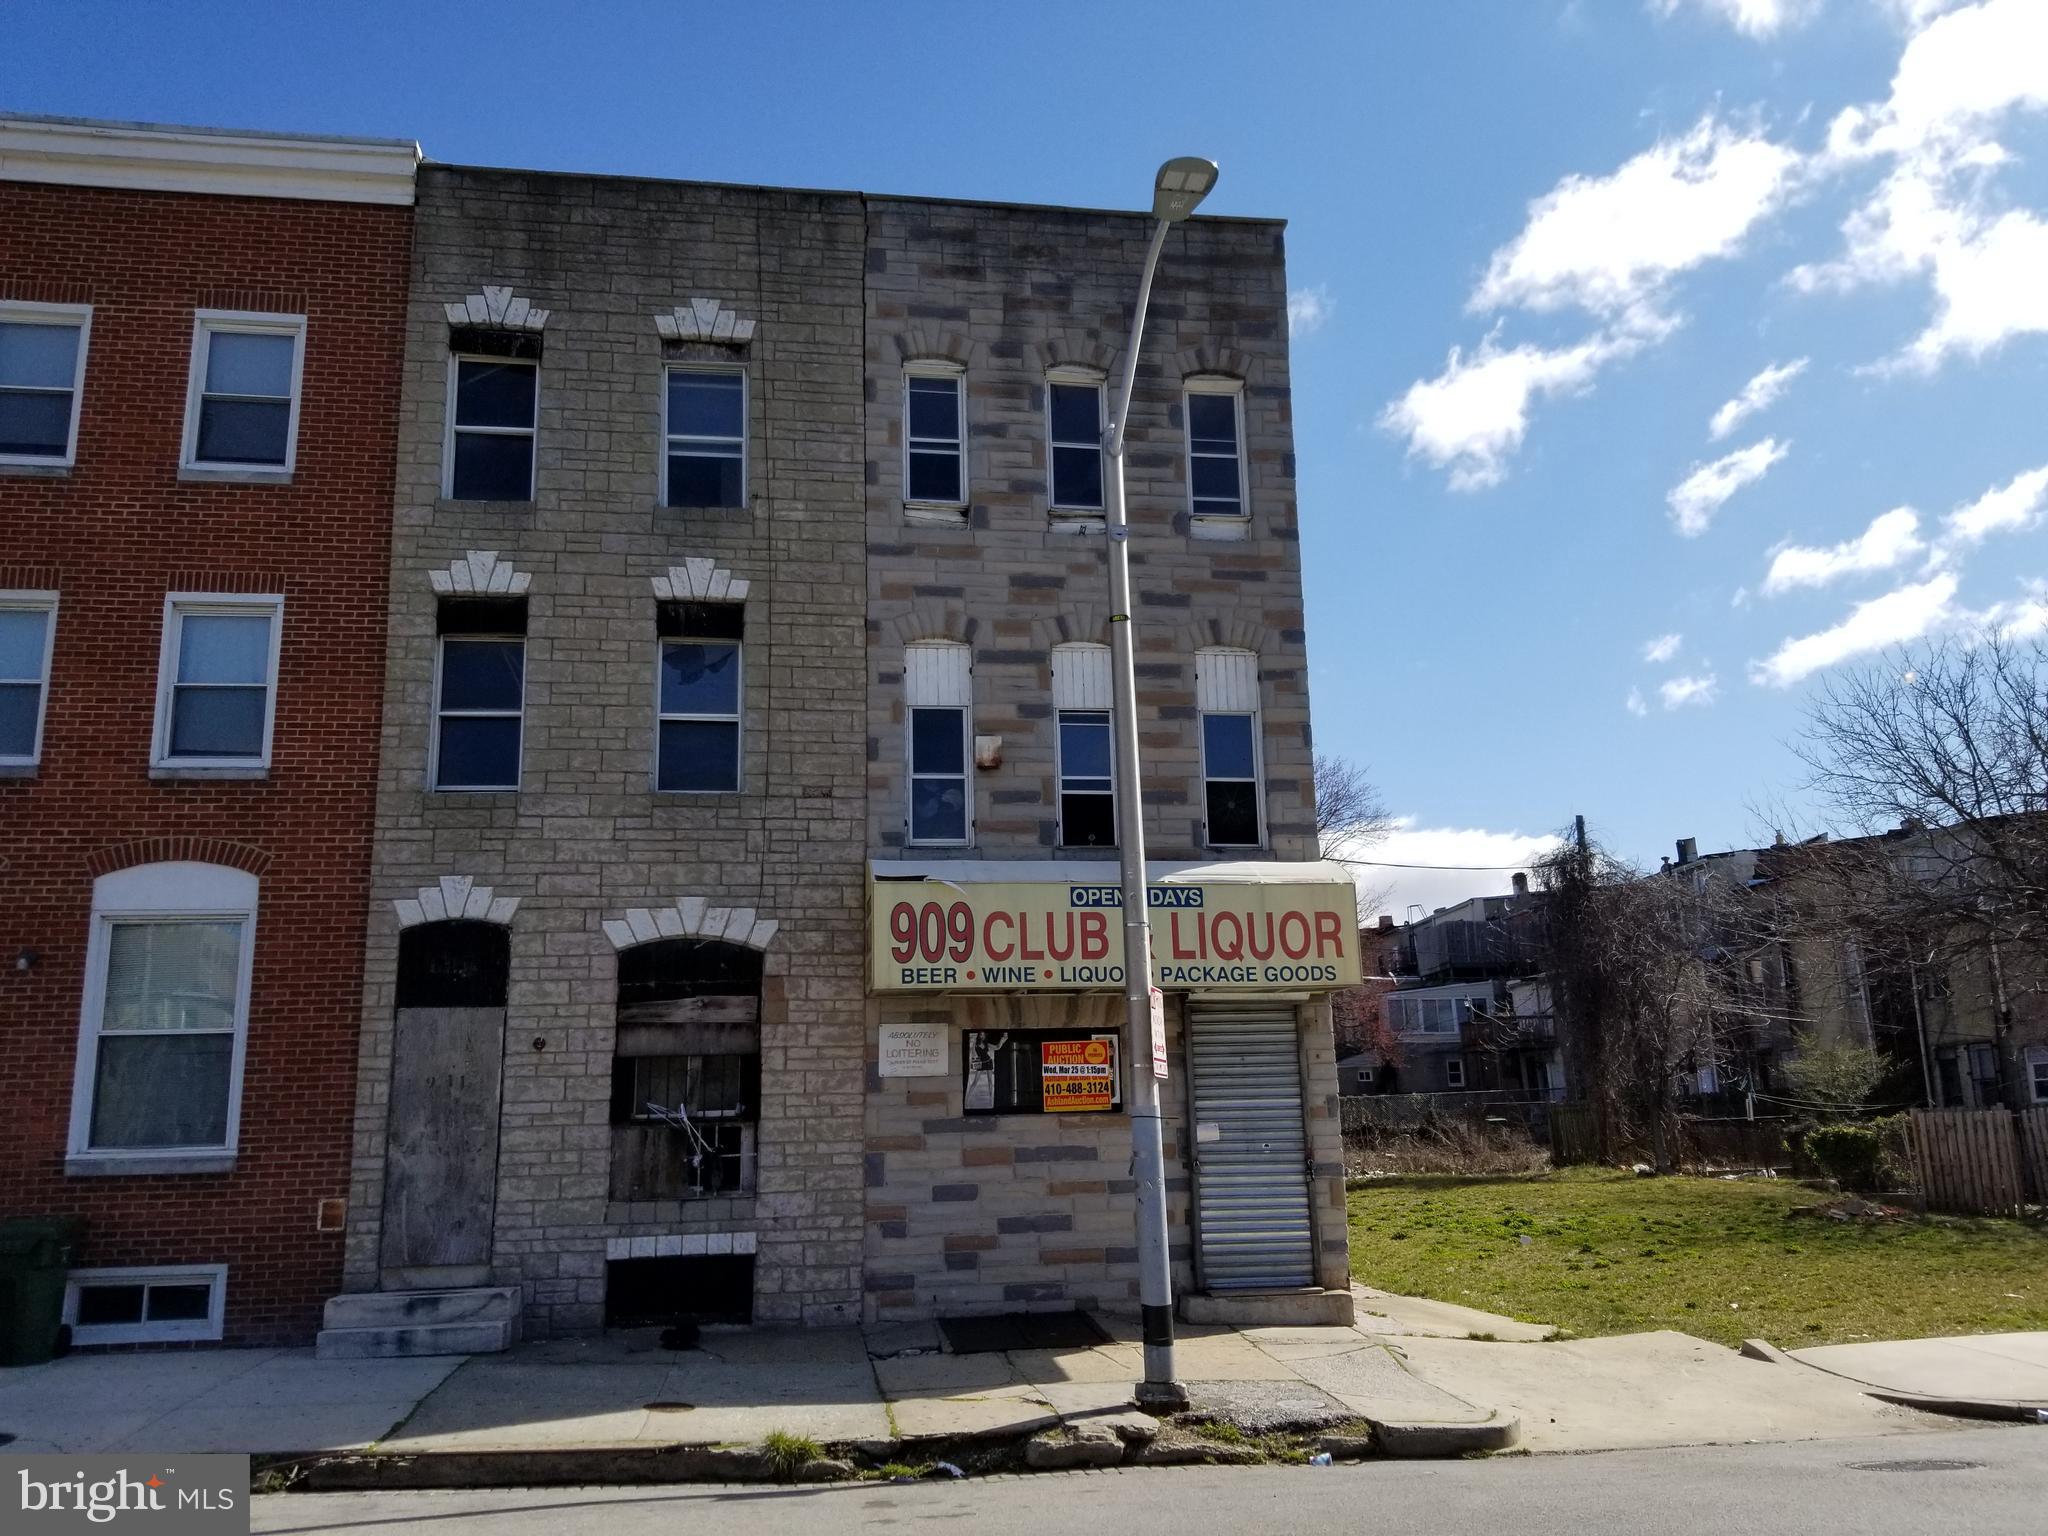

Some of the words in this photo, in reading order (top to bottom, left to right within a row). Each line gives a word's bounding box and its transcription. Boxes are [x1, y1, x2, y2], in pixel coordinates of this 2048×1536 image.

[1151, 889, 1201, 906] DAYS
[890, 901, 975, 964] 909
[983, 911, 1110, 962] CLUB
[1170, 910, 1344, 962] LIQUOR
[901, 968, 957, 984] BEER
[982, 967, 1036, 983] WINE
[1060, 966, 1124, 983] LIQUO
[1161, 966, 1257, 983] PACKAGE
[1264, 965, 1336, 982] GOODS
[886, 1048, 939, 1058] LOITERING
[1050, 1044, 1081, 1054] PUBLIC
[1048, 1054, 1084, 1064] AUCTION
[1058, 1066, 1070, 1074] Mar
[1071, 1066, 1079, 1074] 25
[1045, 1081, 1110, 1095] 410-488-3124
